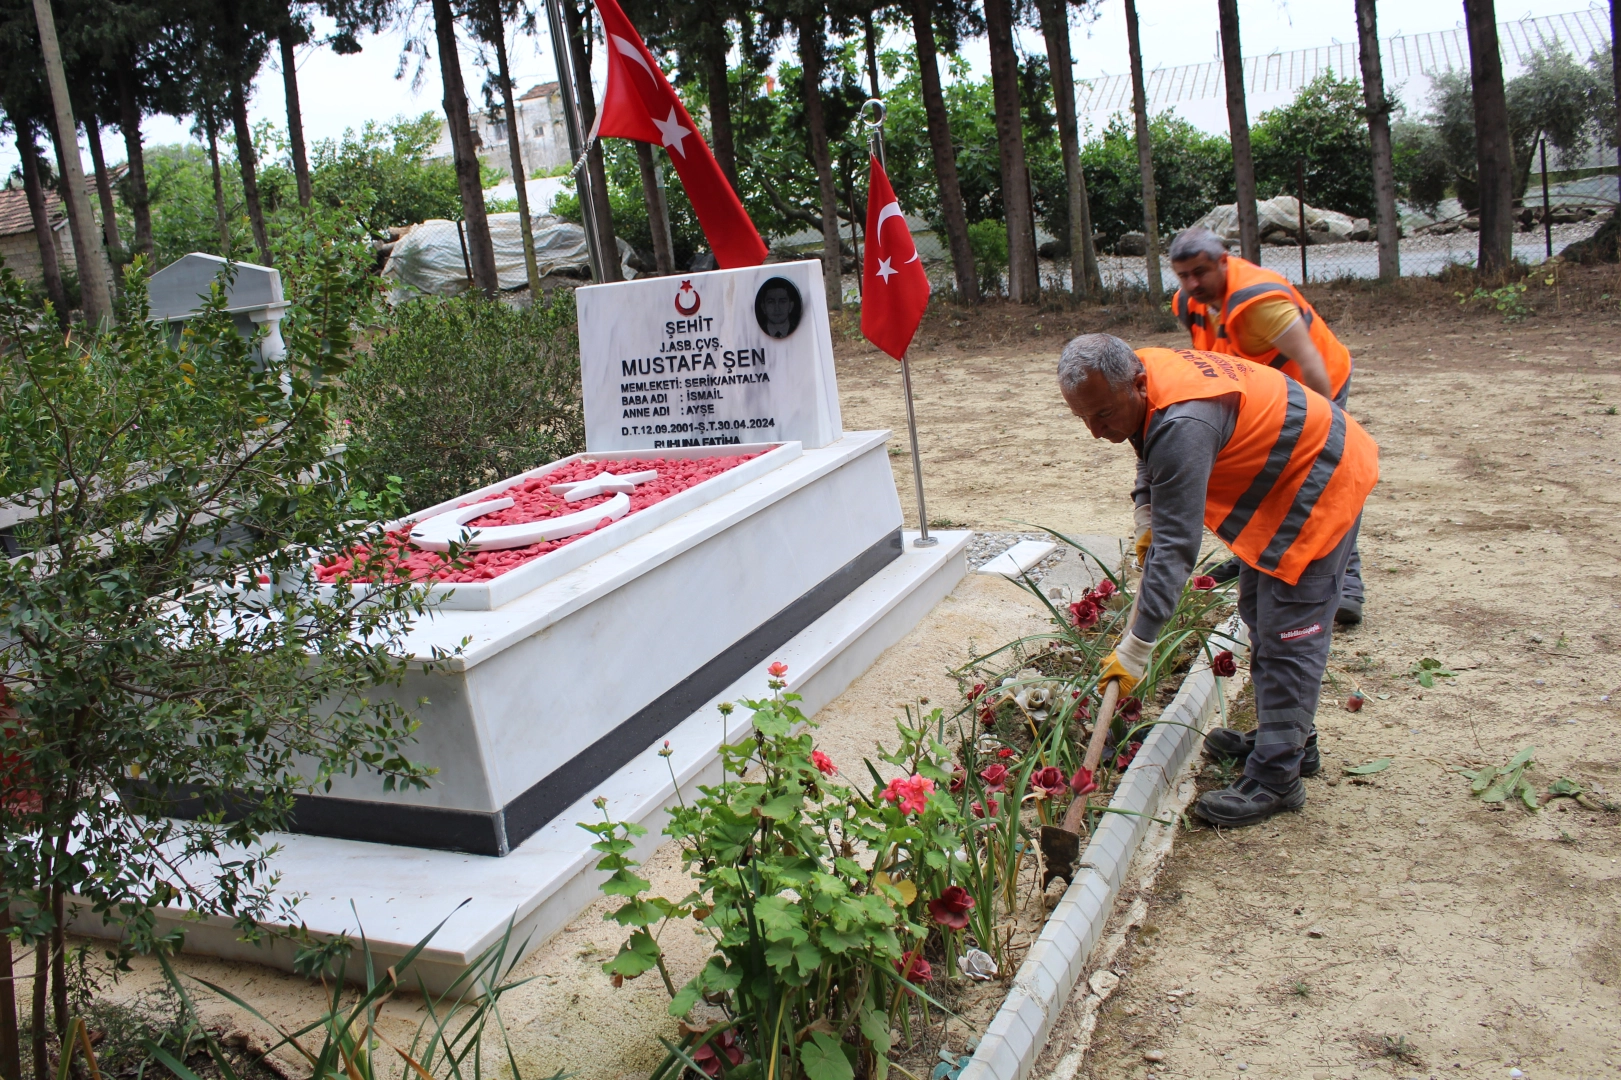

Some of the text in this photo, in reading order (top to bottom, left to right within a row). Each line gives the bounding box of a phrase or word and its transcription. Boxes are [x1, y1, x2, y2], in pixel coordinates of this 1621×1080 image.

[665, 316, 713, 339] ŞEHİT
[659, 337, 723, 353] J.ASB.ÇVŞ.
[621, 348, 766, 377] MUSTAFA ŞEN
[621, 372, 770, 393] MEMLEKETİ: SERİK/ANTALYA
[621, 395, 649, 406] BABA
[650, 393, 668, 404] ADI
[686, 388, 724, 402] İSMAİL
[622, 407, 650, 419] ANNE
[652, 405, 670, 417] ADI
[686, 403, 715, 417] AYŞE
